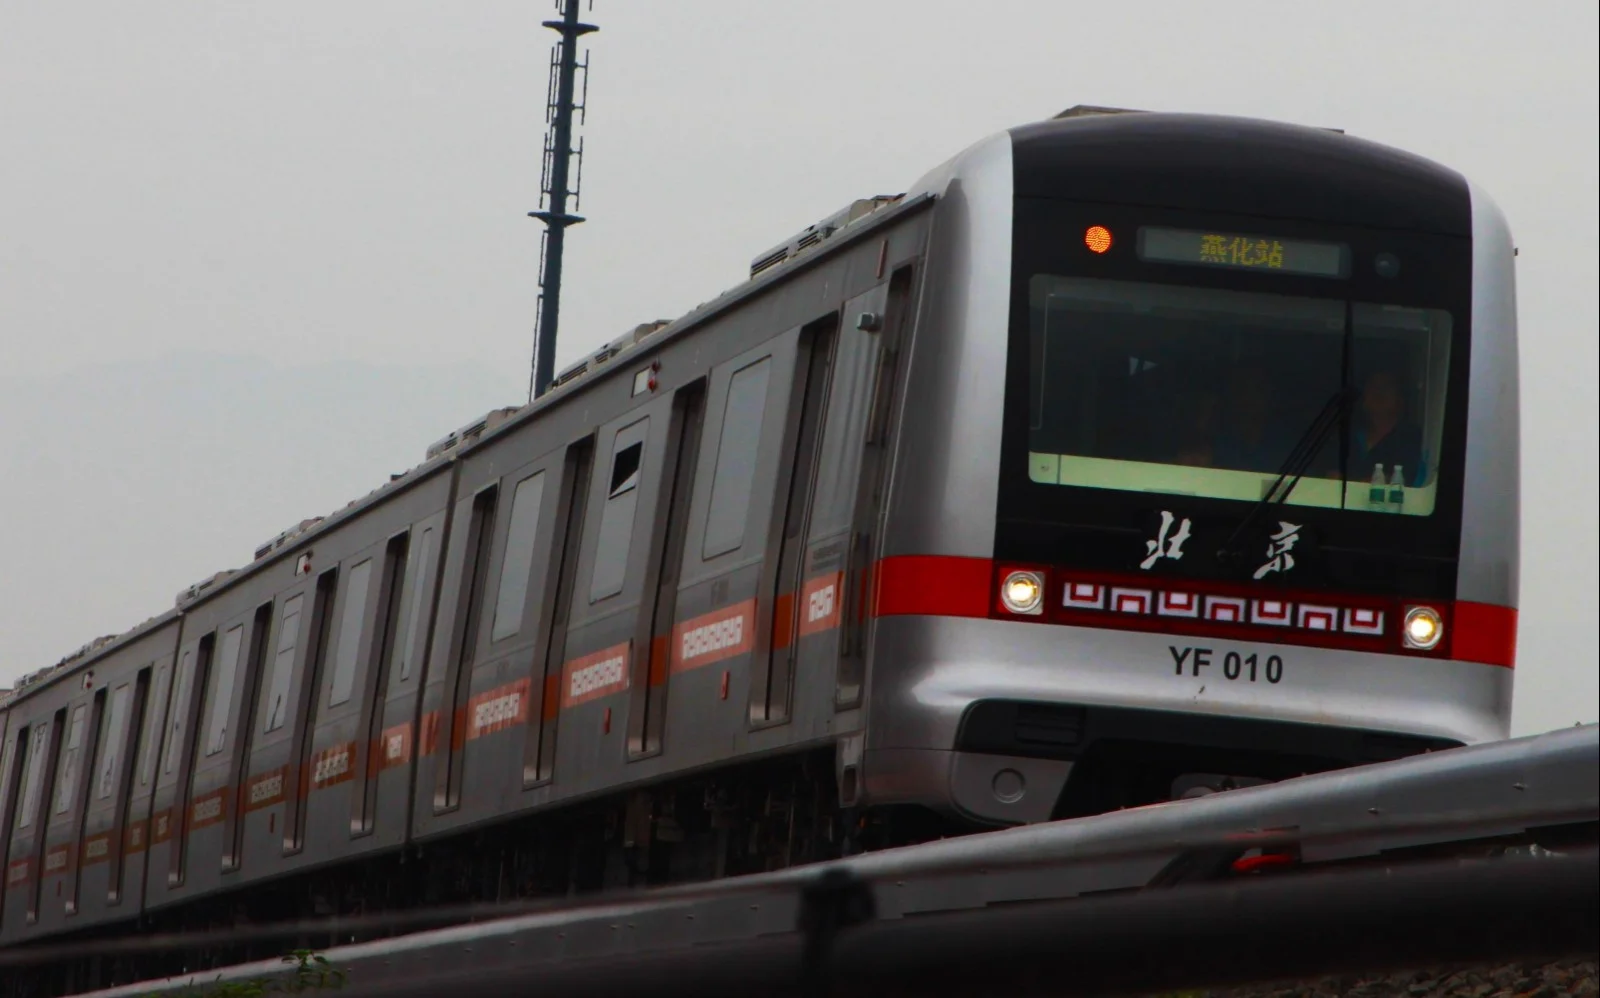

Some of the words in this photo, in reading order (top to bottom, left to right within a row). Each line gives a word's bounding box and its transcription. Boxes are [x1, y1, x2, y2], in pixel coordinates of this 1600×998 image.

[1200, 234, 1284, 268] 燕化站
[1140, 510, 1303, 580] 北京
[1168, 646, 1213, 677] YF
[1223, 651, 1283, 684] 010
